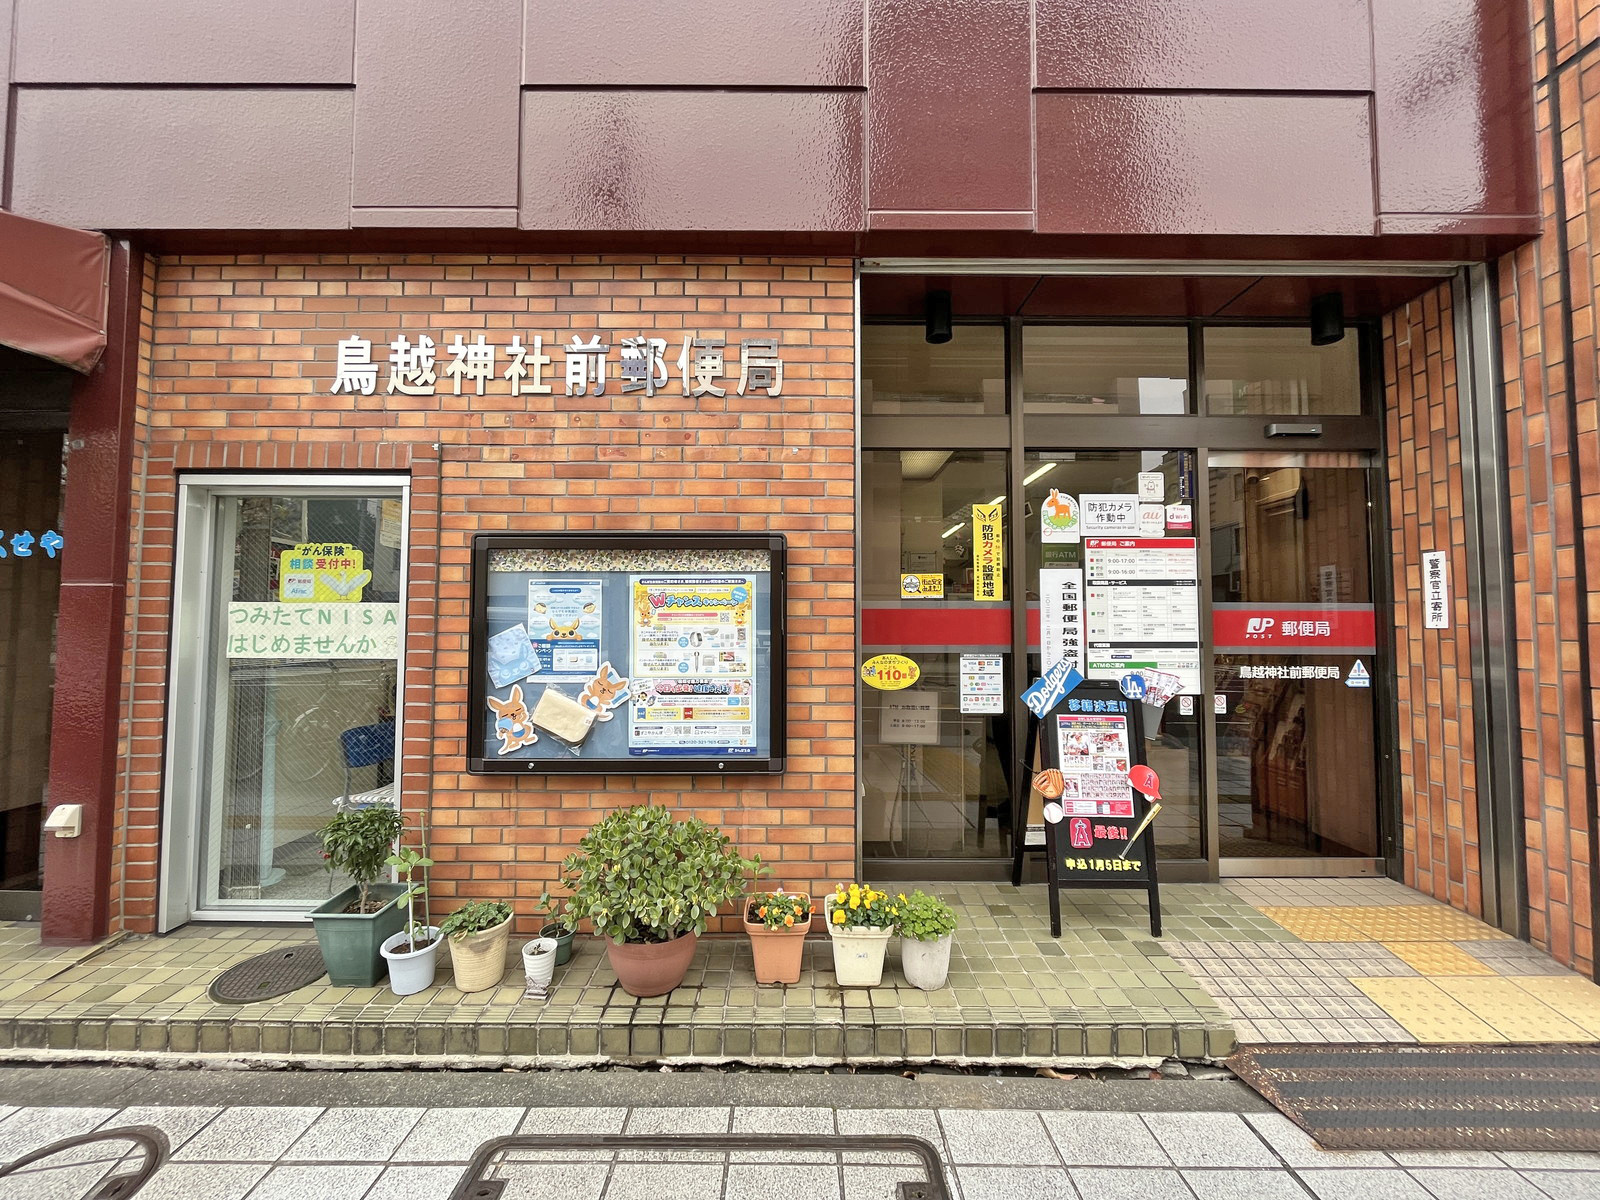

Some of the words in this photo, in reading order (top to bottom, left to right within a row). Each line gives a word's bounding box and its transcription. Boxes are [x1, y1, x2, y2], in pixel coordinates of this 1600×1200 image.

[330, 334, 785, 399] 鳥越神社前郵便局
[1088, 502, 1132, 512] 防犯カメラ
[1142, 511, 1161, 520] au
[1096, 513, 1126, 523] 作動中
[982, 524, 995, 597] 防犯カメラ設置地域
[1428, 558, 1443, 622] 警察官立寄所
[1281, 620, 1331, 637] 郵便局
[228, 634, 377, 654] はじめませんか
[1239, 665, 1340, 680] 鳥越神社前郵便局
[1027, 657, 1072, 714] Dodgers
[1126, 676, 1143, 699] LA
[1068, 698, 1128, 713] 移籍決定!!
[1065, 858, 1142, 872] 申込1月5日まで
